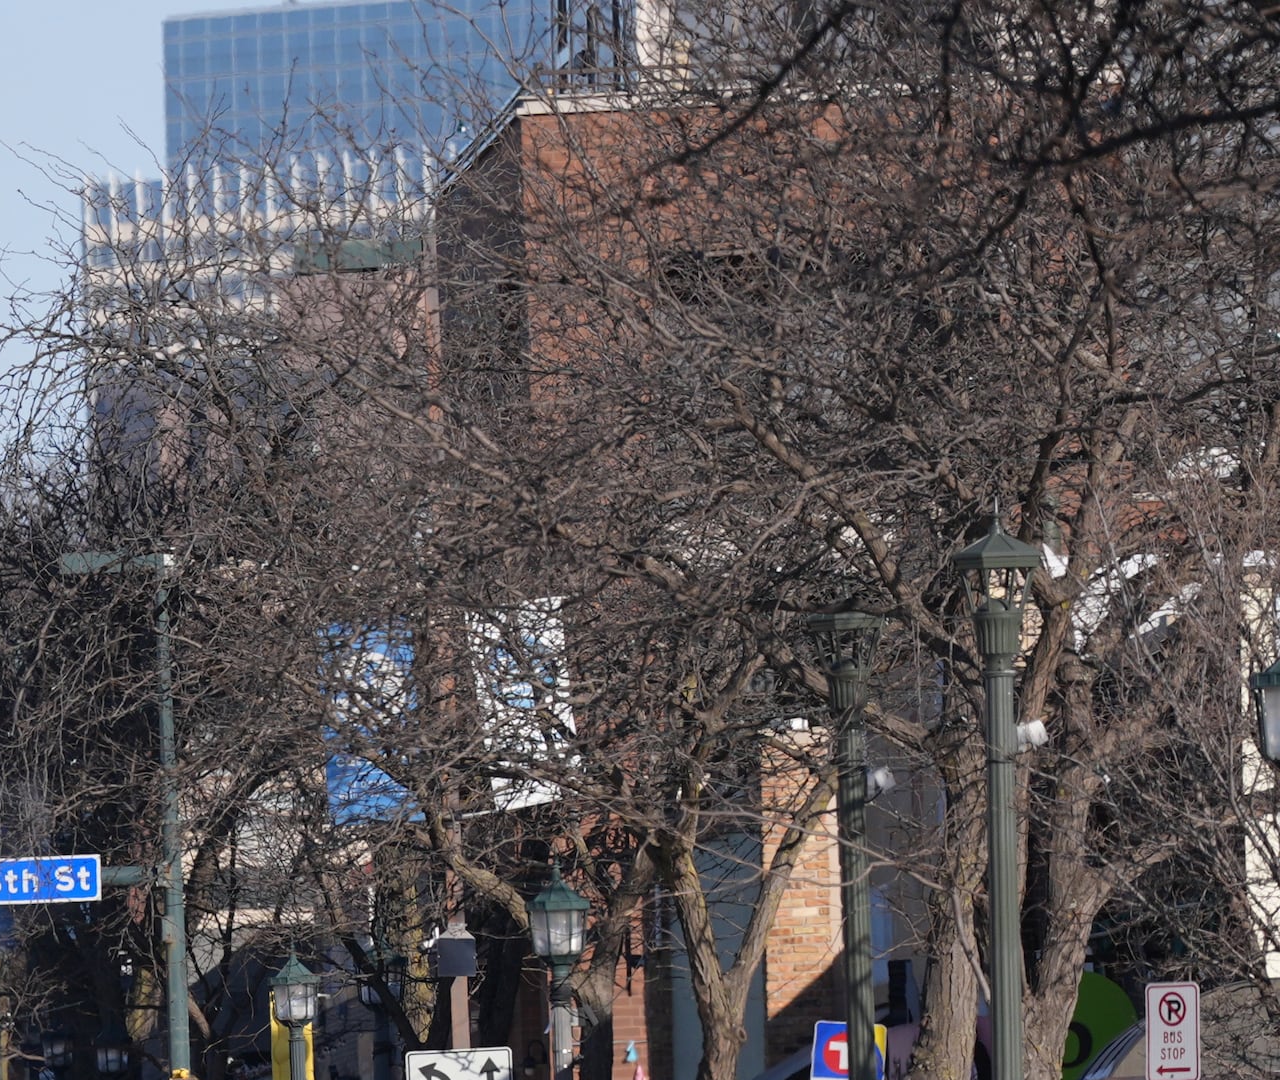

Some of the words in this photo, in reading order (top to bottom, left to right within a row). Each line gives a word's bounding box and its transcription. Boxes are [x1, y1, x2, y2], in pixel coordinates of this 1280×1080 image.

[55, 865, 91, 892] St
[1163, 1031, 1183, 1044] BUS
[1160, 1047, 1186, 1060] STOP
